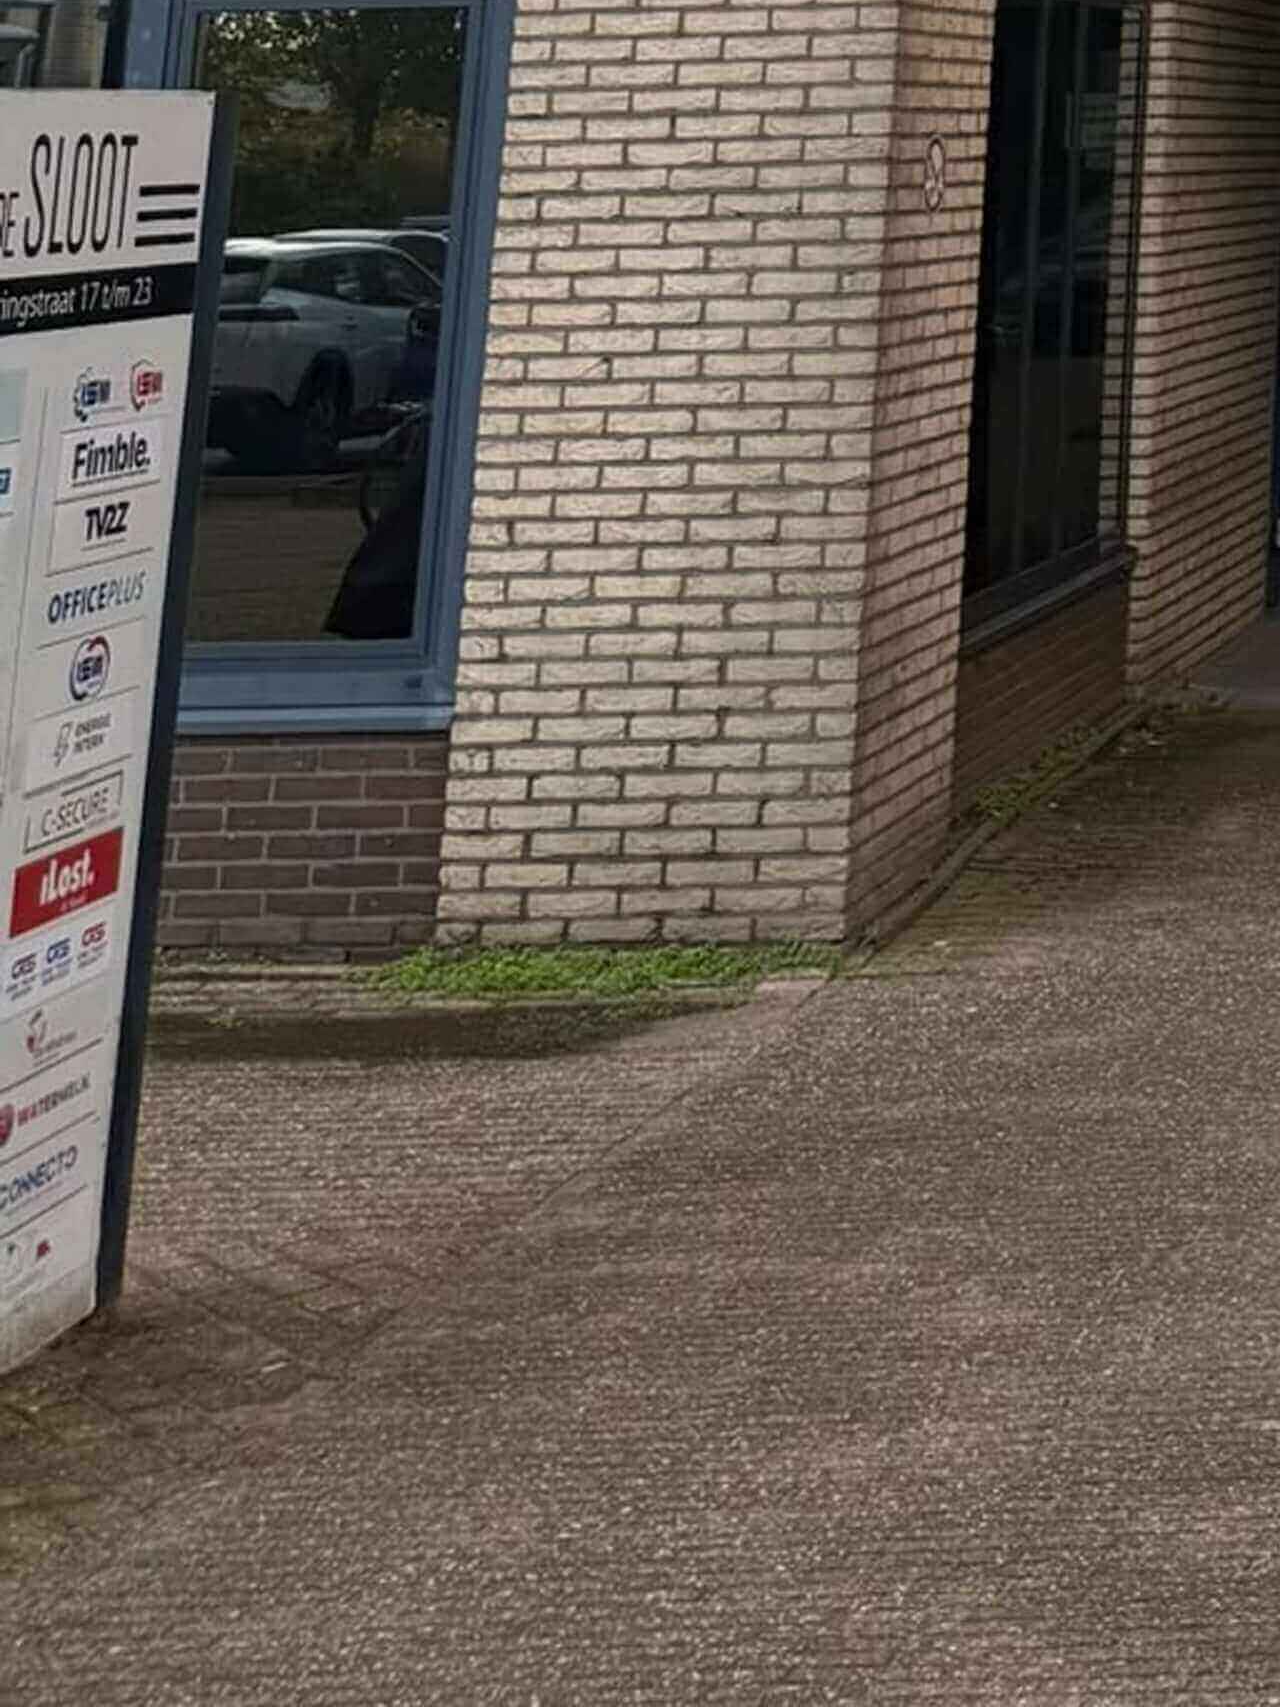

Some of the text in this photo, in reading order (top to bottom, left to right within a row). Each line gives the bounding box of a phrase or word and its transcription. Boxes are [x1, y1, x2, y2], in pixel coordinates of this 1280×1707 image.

[23, 133, 139, 258] SLOOT
[0, 275, 154, 328] ingstraat 17 t/m 23
[72, 431, 151, 480] Fimble.
